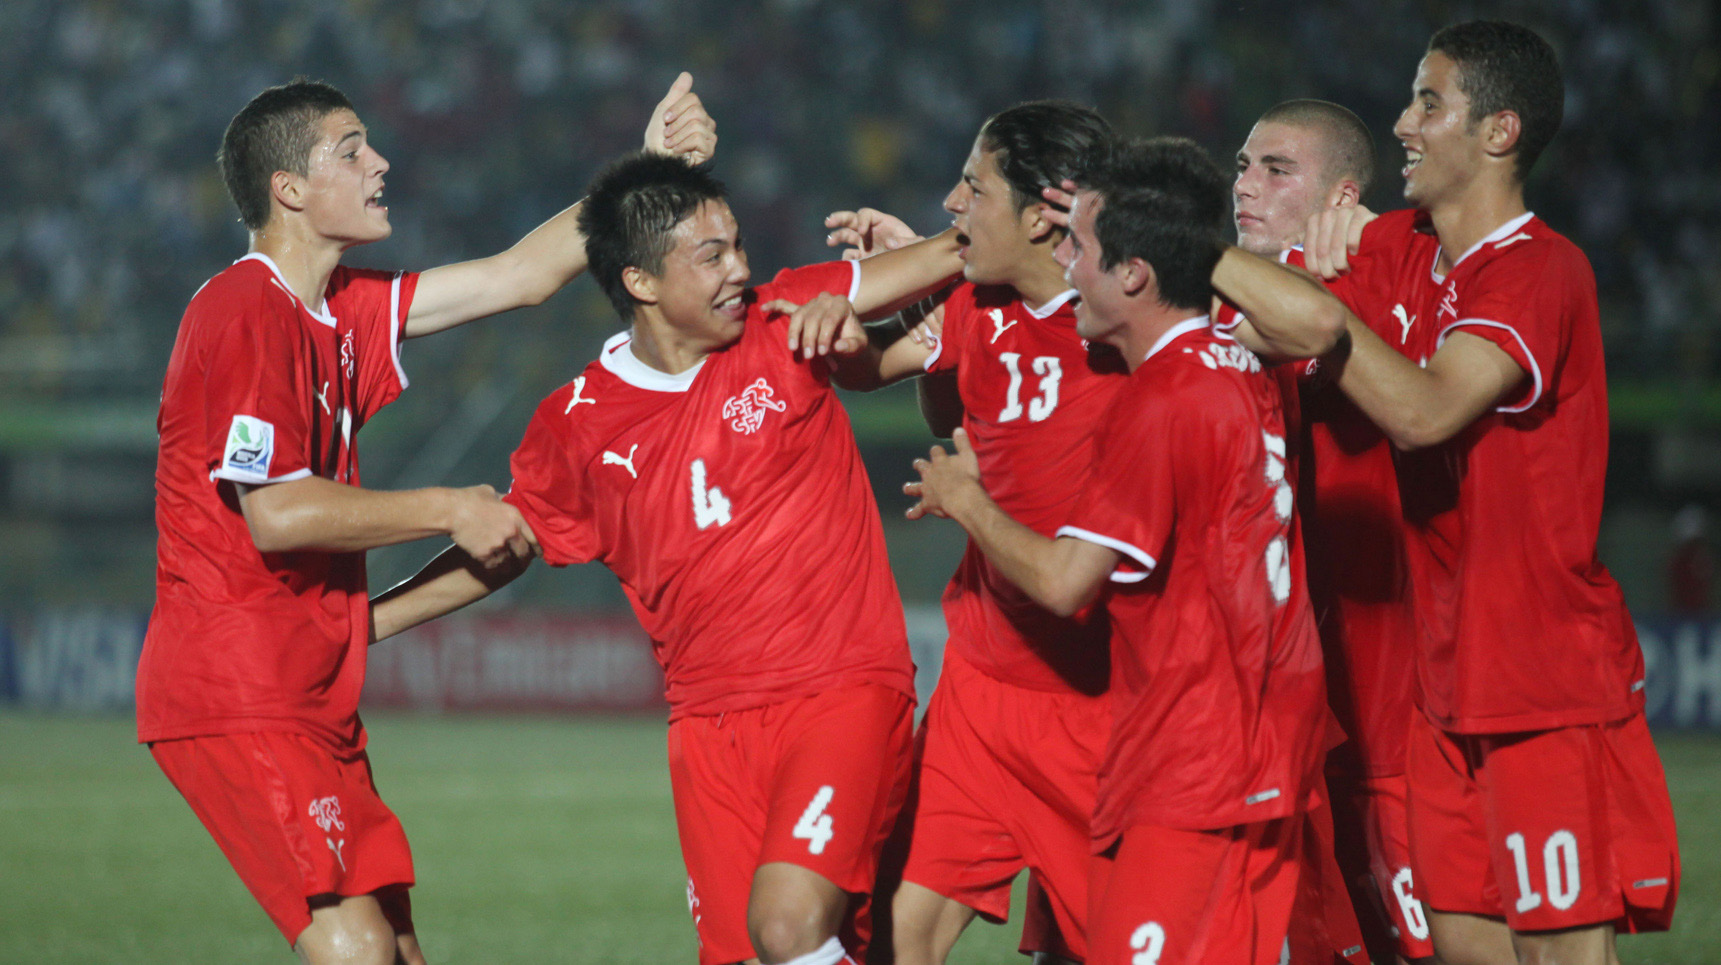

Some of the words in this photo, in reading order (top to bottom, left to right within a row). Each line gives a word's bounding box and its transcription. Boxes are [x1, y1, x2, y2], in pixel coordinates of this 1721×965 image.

[998, 351, 1063, 423] 13
[689, 458, 733, 531] 4
[792, 785, 834, 855] 4
[1506, 829, 1581, 913] 10
